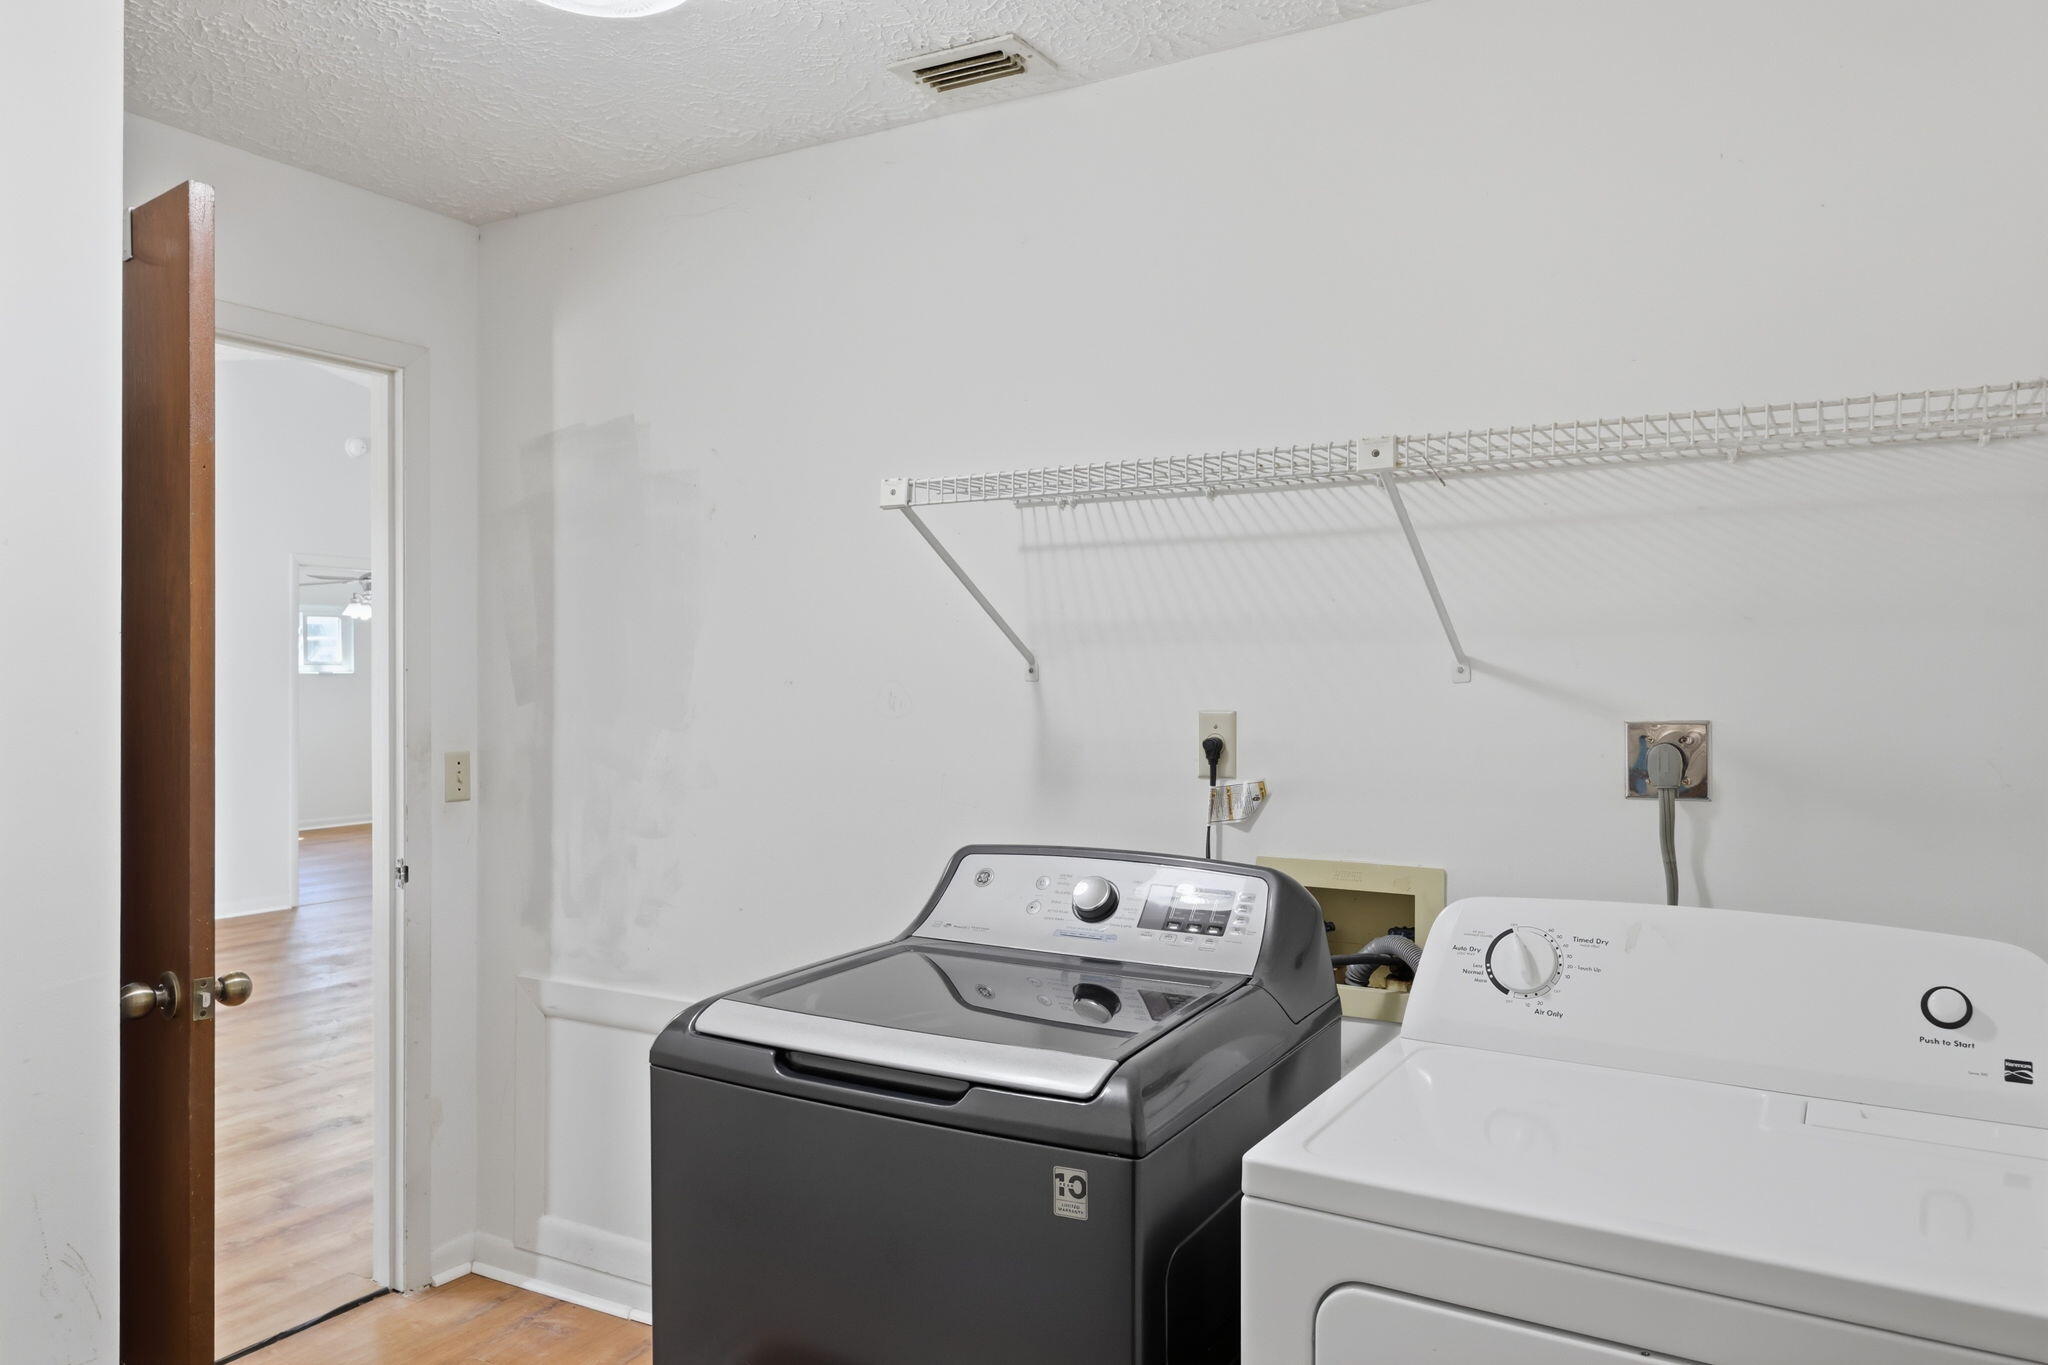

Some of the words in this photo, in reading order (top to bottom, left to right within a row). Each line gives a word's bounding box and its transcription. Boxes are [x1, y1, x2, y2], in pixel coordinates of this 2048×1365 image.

[1572, 936, 1594, 944] Timed
[1596, 938, 1609, 946] Dry
[1462, 968, 1484, 976] Normal
[1546, 1009, 1563, 1018] Only
[1919, 1036, 1940, 1045] Push
[1953, 1040, 1975, 1049] Start
[1055, 1173, 1087, 1199] 10
